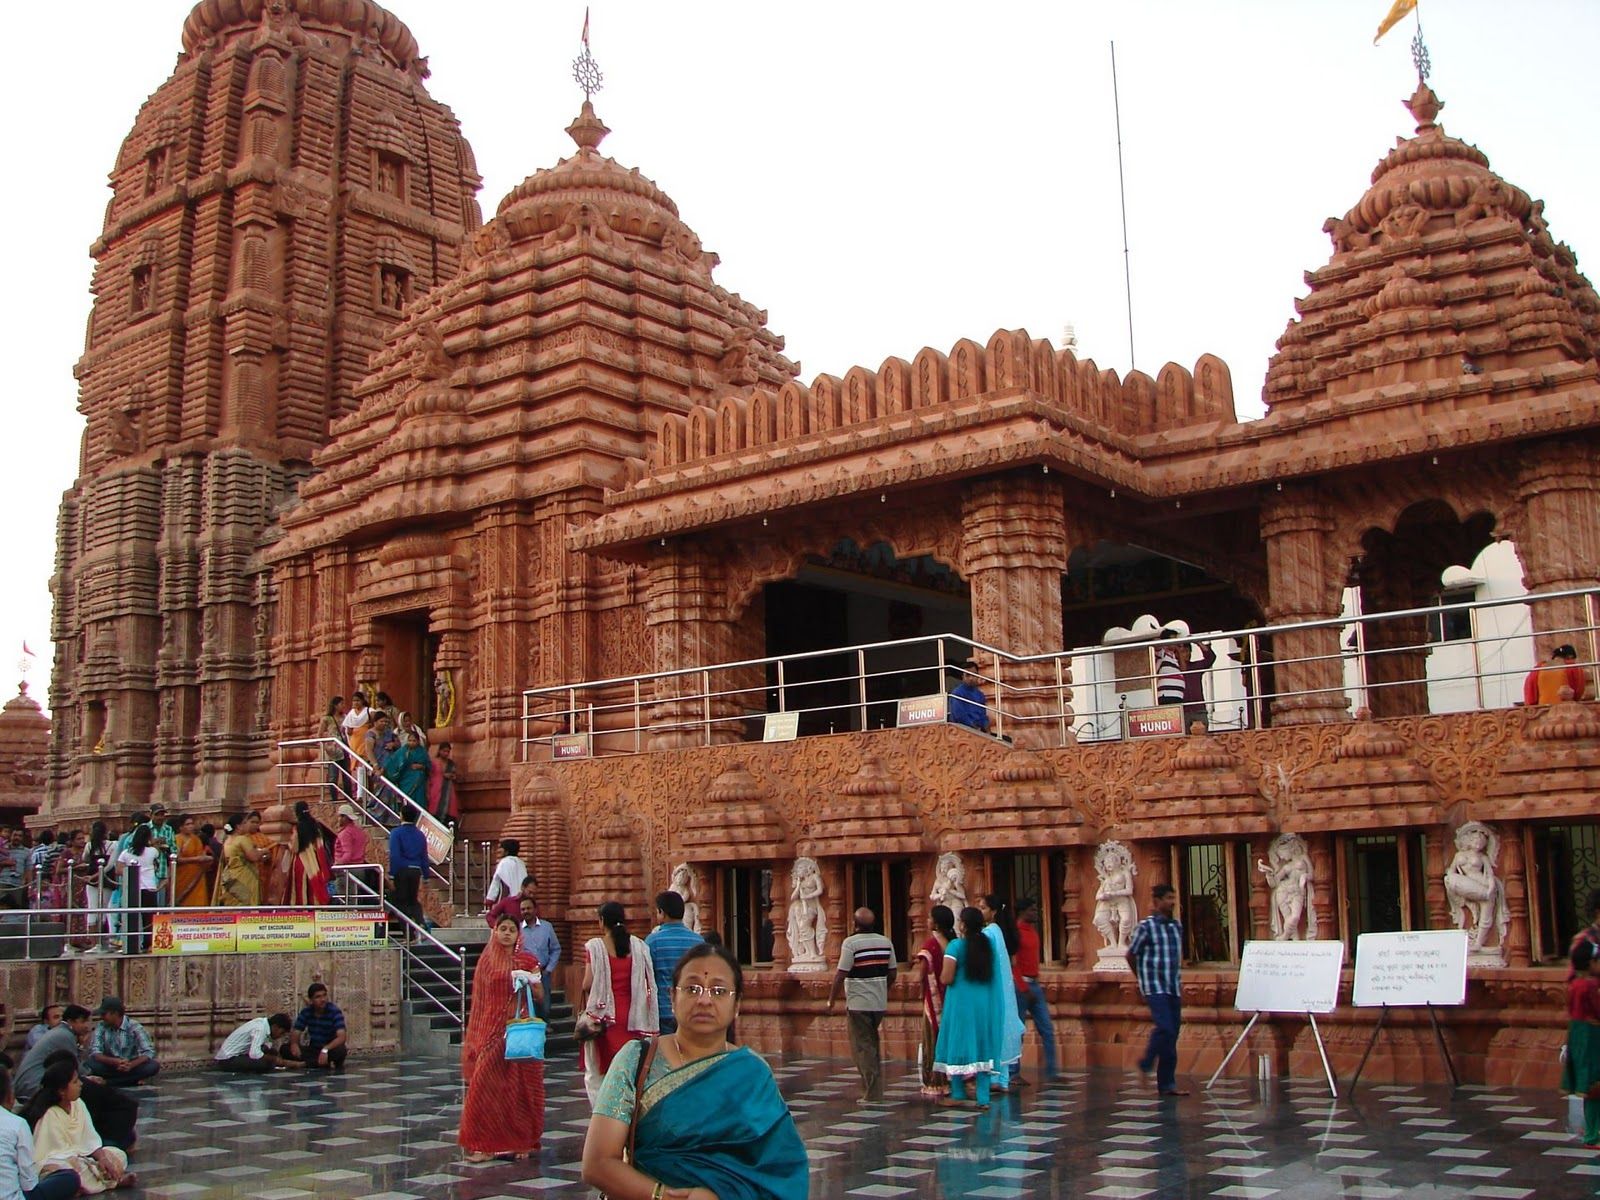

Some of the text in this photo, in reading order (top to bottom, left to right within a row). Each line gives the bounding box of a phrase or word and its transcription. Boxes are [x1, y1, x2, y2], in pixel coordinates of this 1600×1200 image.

[908, 709, 936, 720] HUNDI
[1140, 721, 1171, 732] HUNDI
[561, 746, 581, 755] HUNDI
